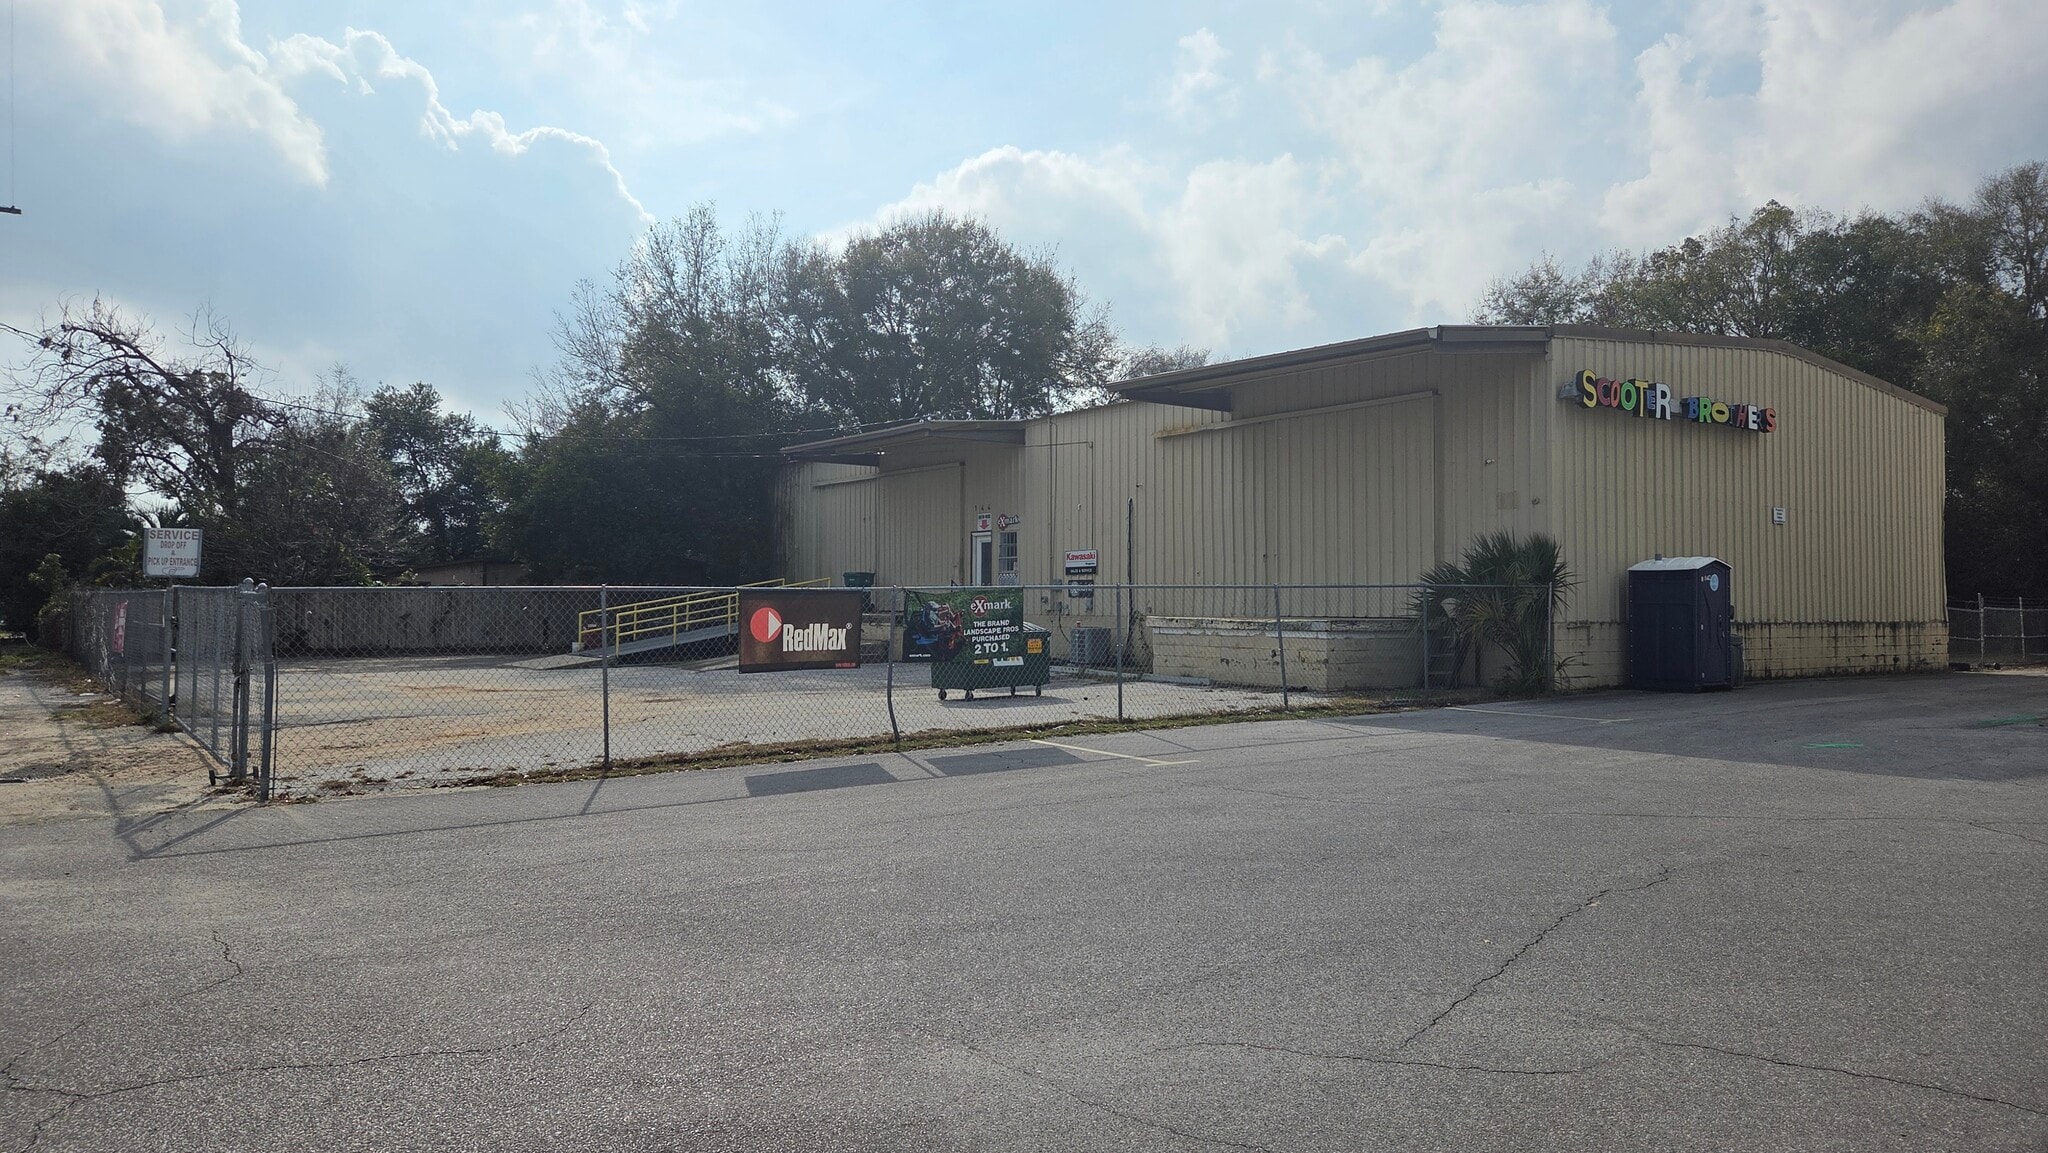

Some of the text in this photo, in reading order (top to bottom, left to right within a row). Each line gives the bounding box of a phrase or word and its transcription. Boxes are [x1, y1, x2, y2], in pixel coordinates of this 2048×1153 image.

[1578, 369, 1777, 433] SCOOTER BROTHERS
[149, 530, 200, 540] SERVICE
[160, 541, 175, 549] DROP
[1066, 552, 1096, 561] Kawasaki
[148, 557, 198, 567] PICK UP ENTRANCE
[987, 620, 1010, 628] BRAND
[963, 625, 1020, 636] LANDSCAPE PROS
[971, 634, 1010, 643] PURCHASED
[974, 642, 1009, 655] 2 TO 1.
